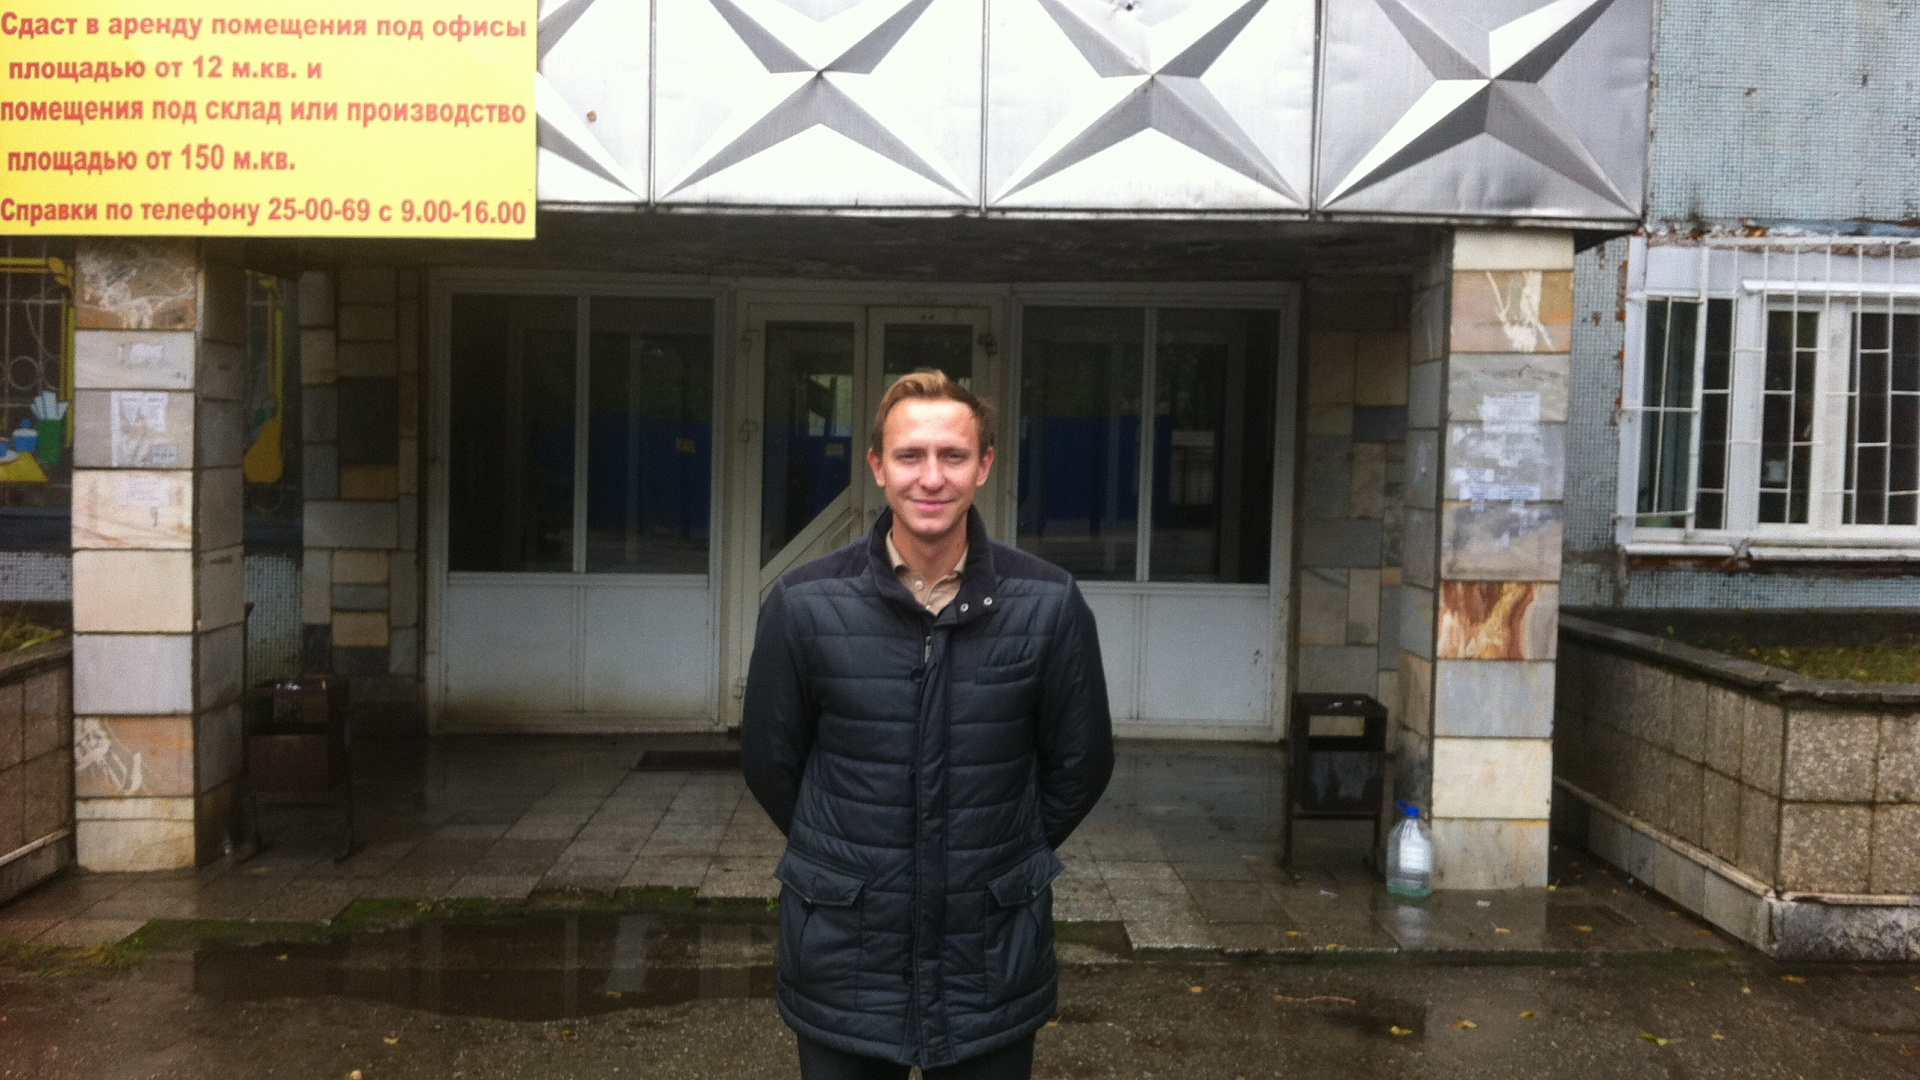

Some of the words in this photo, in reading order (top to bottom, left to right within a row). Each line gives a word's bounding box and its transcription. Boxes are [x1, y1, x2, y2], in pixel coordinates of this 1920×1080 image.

[0, 10, 79, 40] Сдаст
[85, 17, 100, 36] в
[107, 16, 203, 41] аренду
[211, 17, 367, 39] помещения
[376, 19, 424, 41] под
[432, 14, 526, 43] офисы
[8, 60, 147, 84] площадью
[154, 60, 184, 79] от
[192, 54, 223, 79] 12
[232, 61, 297, 79] м.кв.
[307, 62, 323, 79] и
[0, 99, 144, 126] помещения
[152, 99, 198, 125] под
[205, 100, 283, 125] склад
[290, 101, 338, 121] или
[347, 101, 527, 128] производство
[7, 150, 139, 176] площадью
[145, 150, 173, 171] от
[180, 143, 225, 171] 150
[233, 150, 296, 171] м.кв.
[0, 196, 99, 228] Справки
[105, 202, 134, 221] по
[140, 196, 261, 227] телефону
[267, 196, 371, 223] 25-00-69
[378, 204, 392, 223] с
[400, 198, 527, 225] 9.00-16.00
